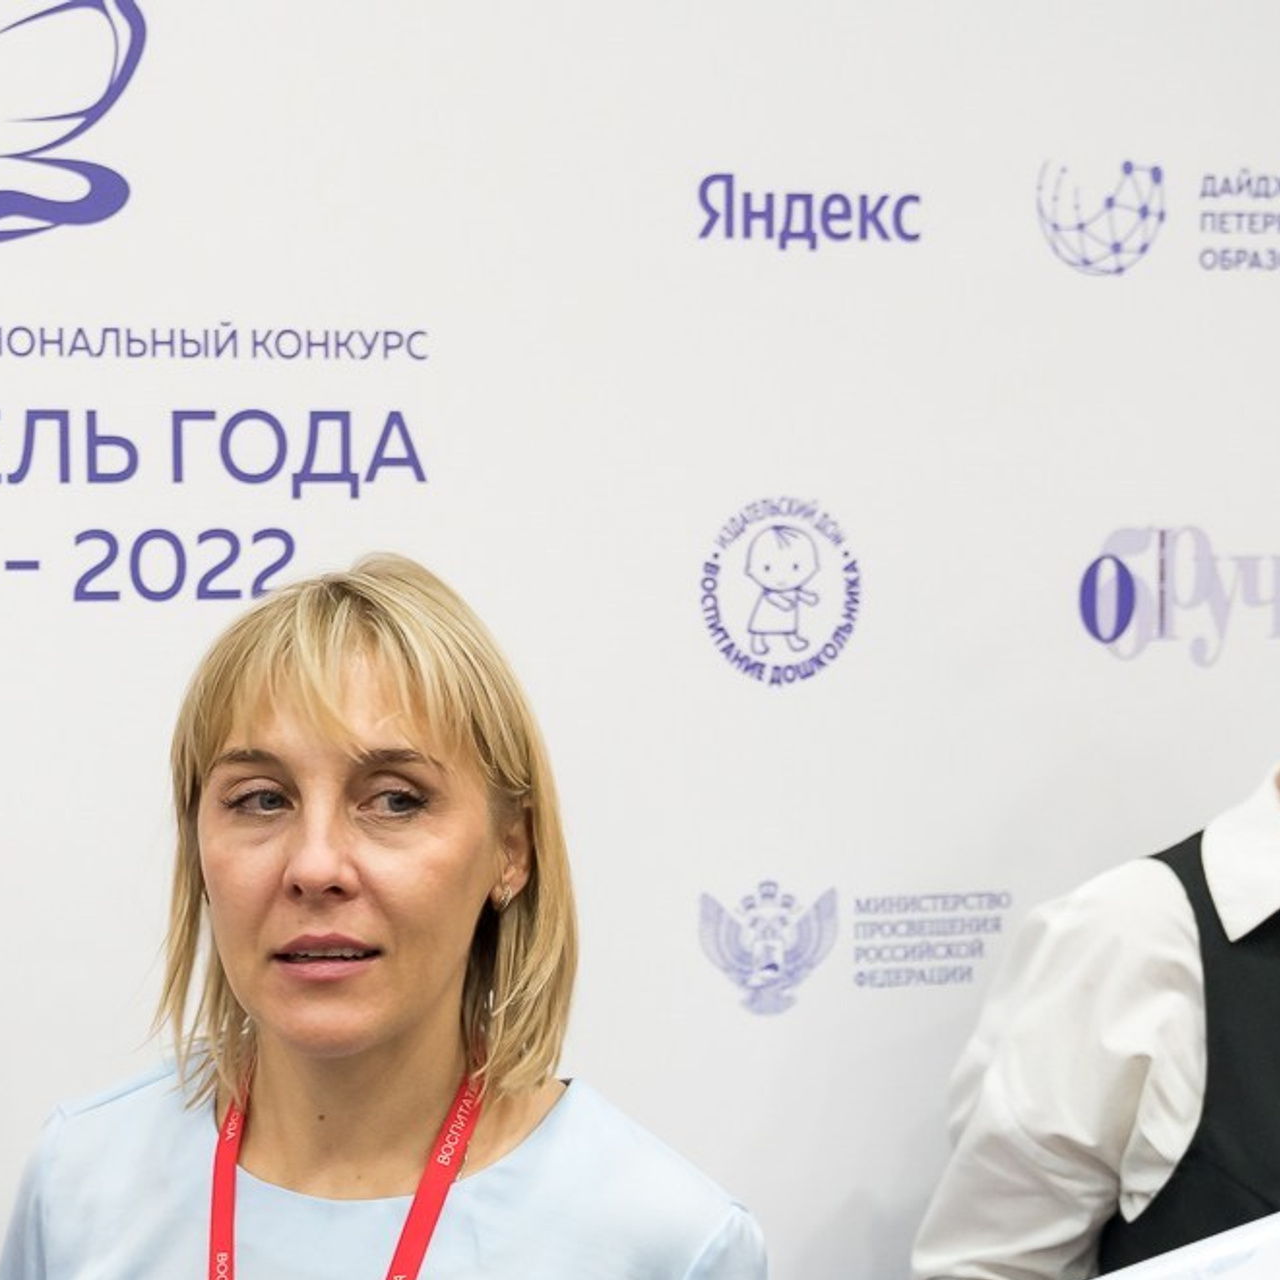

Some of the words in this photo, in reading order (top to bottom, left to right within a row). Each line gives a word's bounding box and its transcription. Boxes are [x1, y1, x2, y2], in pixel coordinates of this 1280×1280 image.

[1200, 167, 1280, 199] ДАЙД
[698, 174, 920, 251] Яндекс
[1200, 211, 1280, 234] ПЕТЕР
[1200, 247, 1280, 271] ОБРАЗ
[251, 329, 429, 361] КОНКУРС
[171, 408, 427, 500] ГОДА
[73, 528, 295, 602] 2022
[701, 561, 766, 681] ВОСПИТАНИЕ
[768, 560, 859, 688] ДОШКОЛЬНИКА
[854, 891, 1013, 915] МИНИСТЕРСТВО
[854, 916, 1002, 940] ПРОСВЕЩЕНИЯ
[854, 938, 984, 963] РОССИЙСКОЙ
[854, 965, 974, 988] ФЕДЕРАЦИИ
